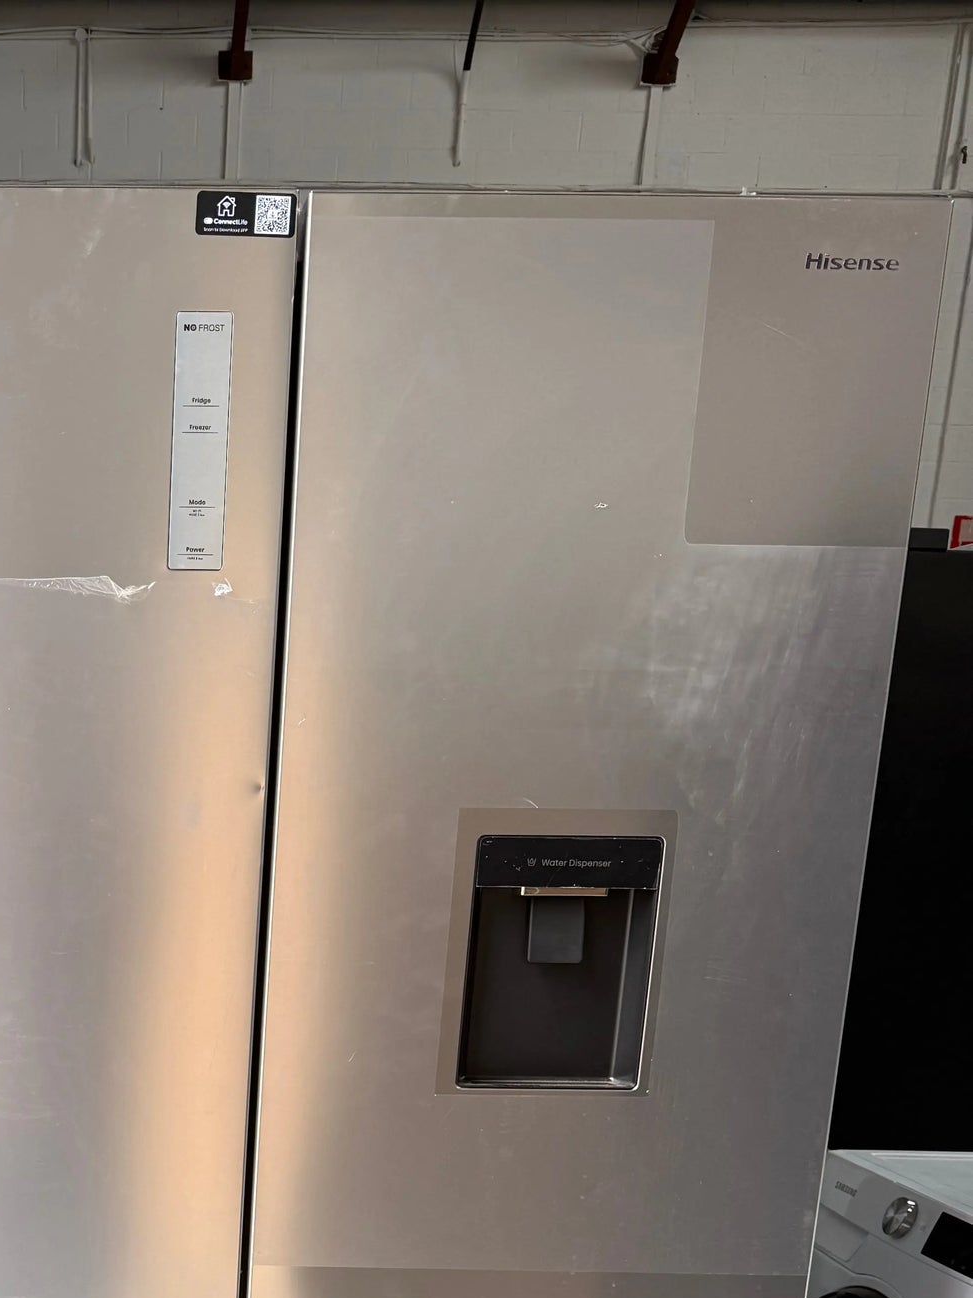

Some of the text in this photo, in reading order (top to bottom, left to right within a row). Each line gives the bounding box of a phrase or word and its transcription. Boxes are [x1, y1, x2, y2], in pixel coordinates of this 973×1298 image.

[213, 218, 248, 226] ConnectLife
[805, 252, 900, 271] Hisense
[184, 324, 225, 332] NO FROST
[542, 858, 612, 868] Water Dispenser
[835, 1180, 858, 1197] SAMSUNG
